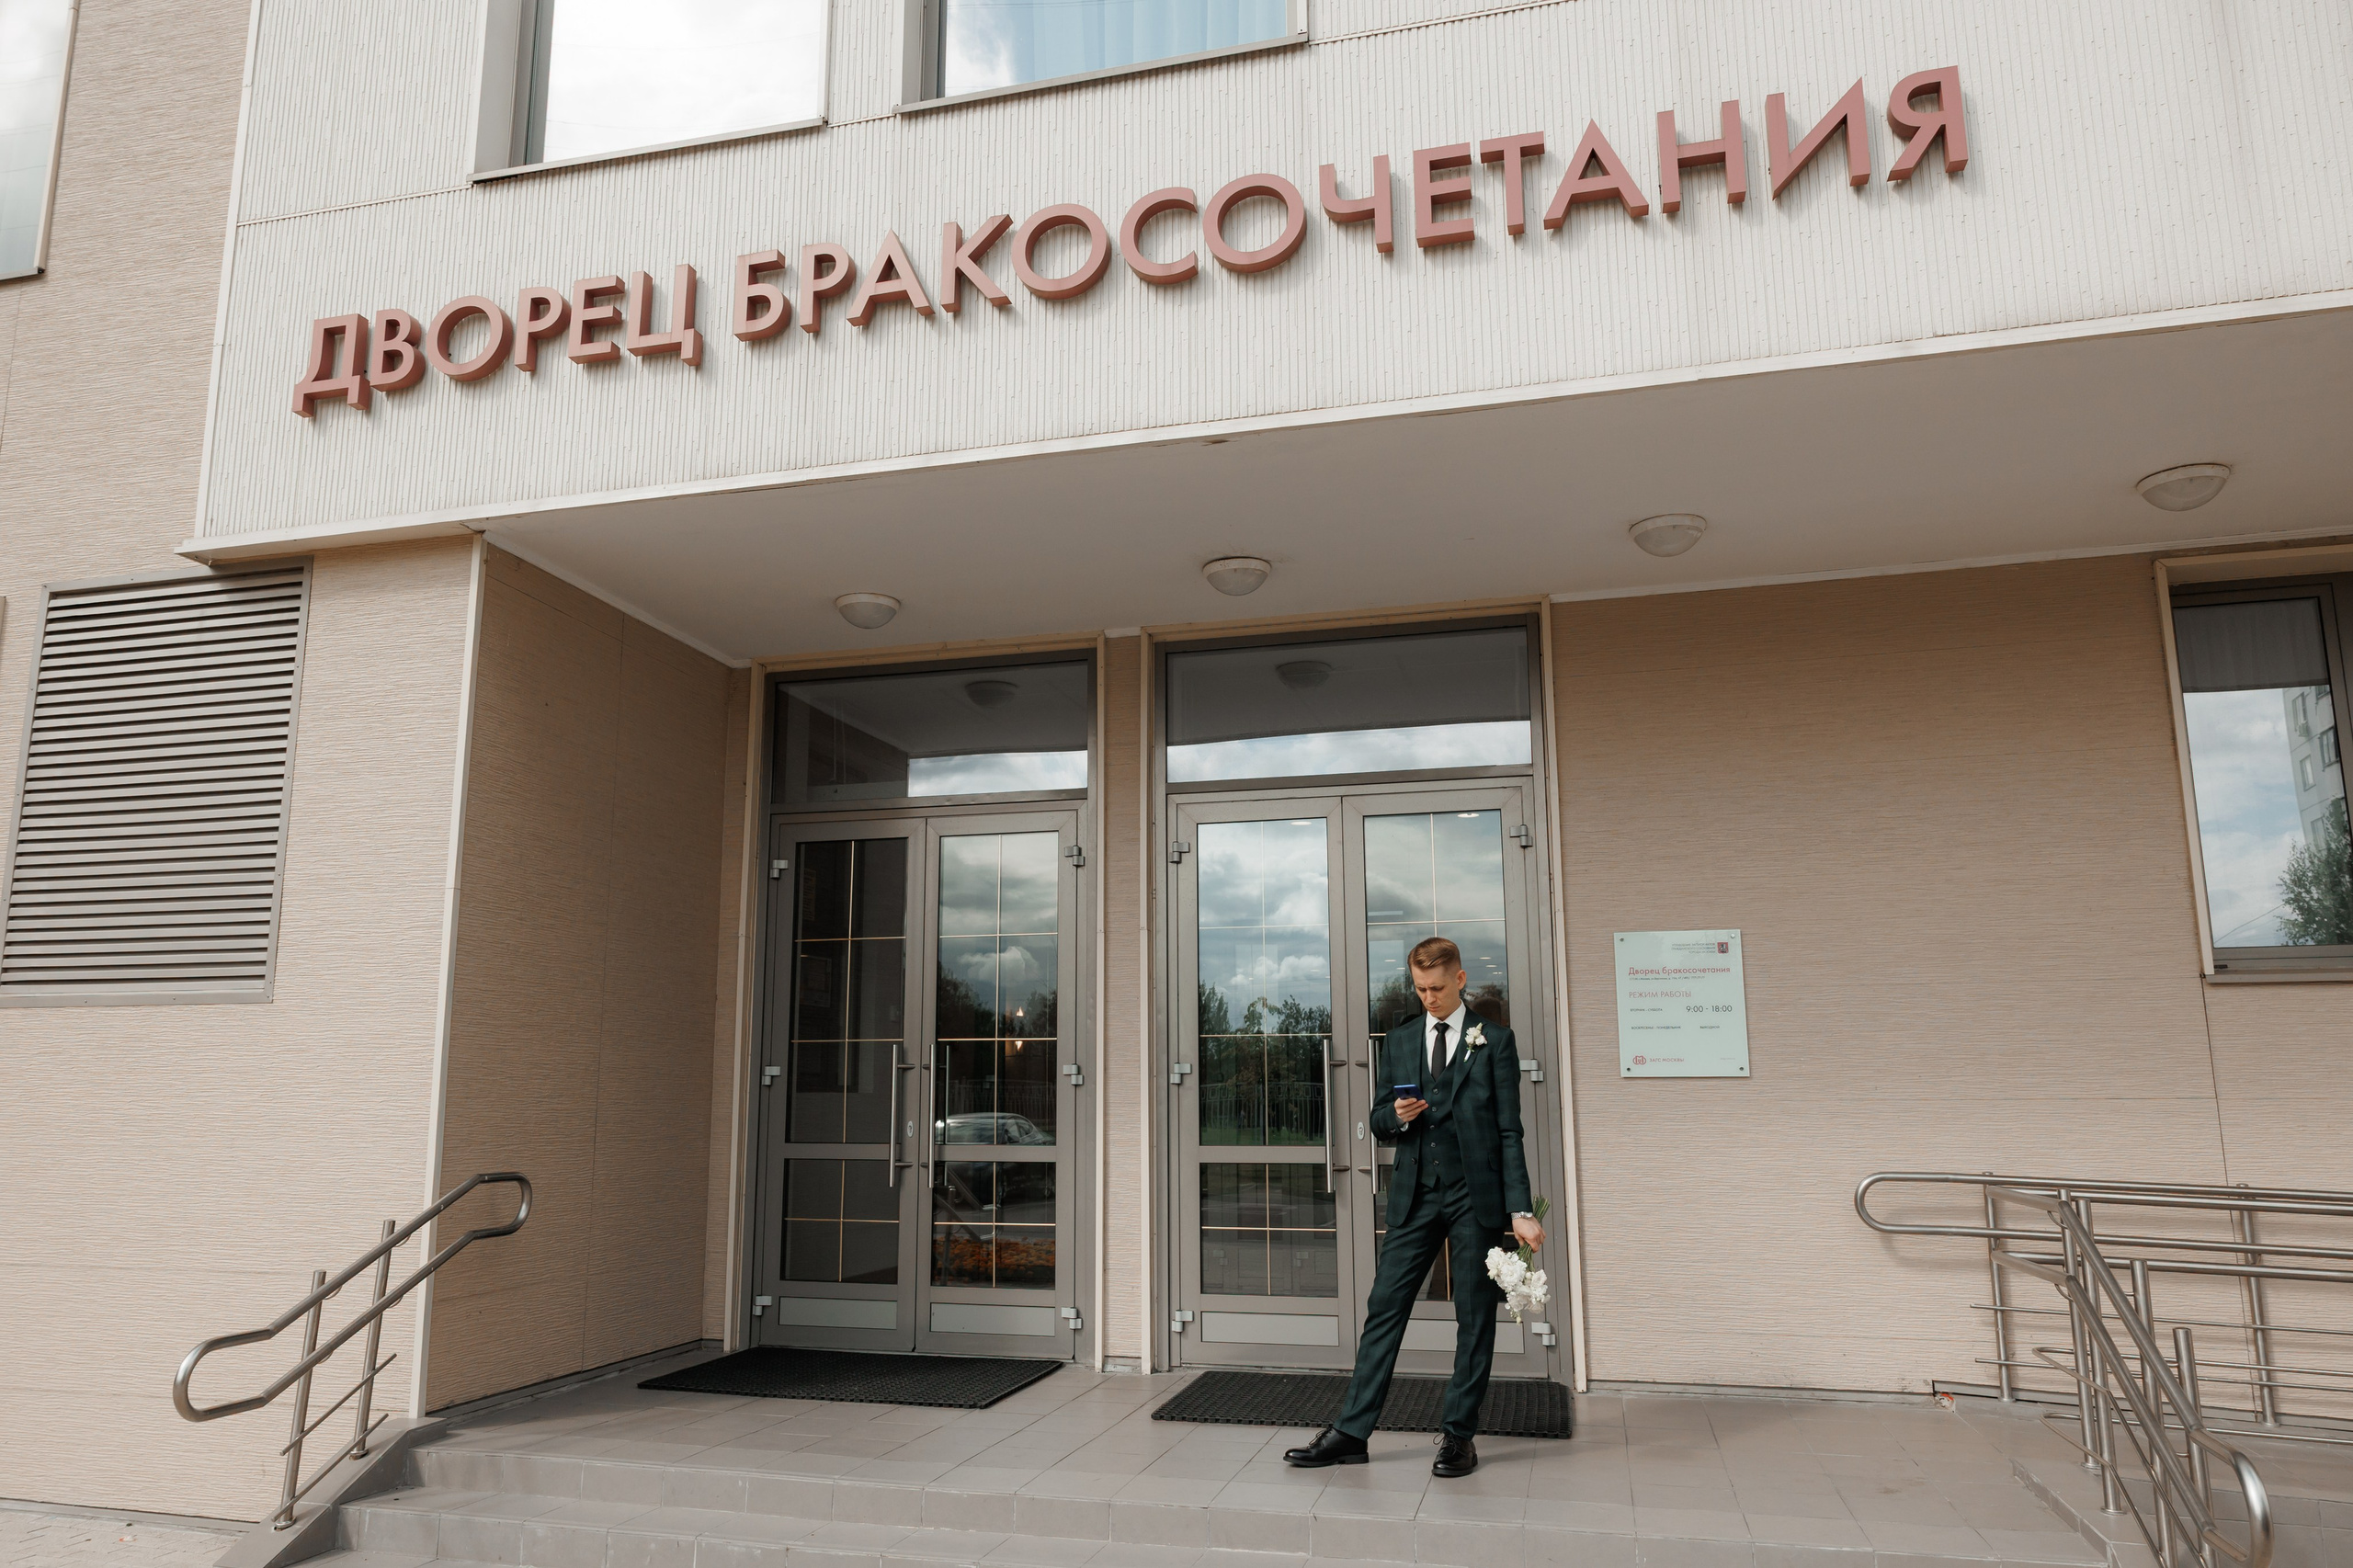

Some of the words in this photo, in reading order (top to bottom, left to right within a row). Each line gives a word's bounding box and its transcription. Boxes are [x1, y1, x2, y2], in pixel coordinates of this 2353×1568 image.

[291, 262, 703, 418] ДВОРЕЦ
[733, 65, 1969, 342] БРАКОСОЧЕТАНИЯ
[1628, 967, 1660, 976] Дворец
[1662, 966, 1731, 975] бракосочетания
[1686, 1005, 1704, 1013] 9:00
[1711, 1005, 1733, 1013] 18:00
